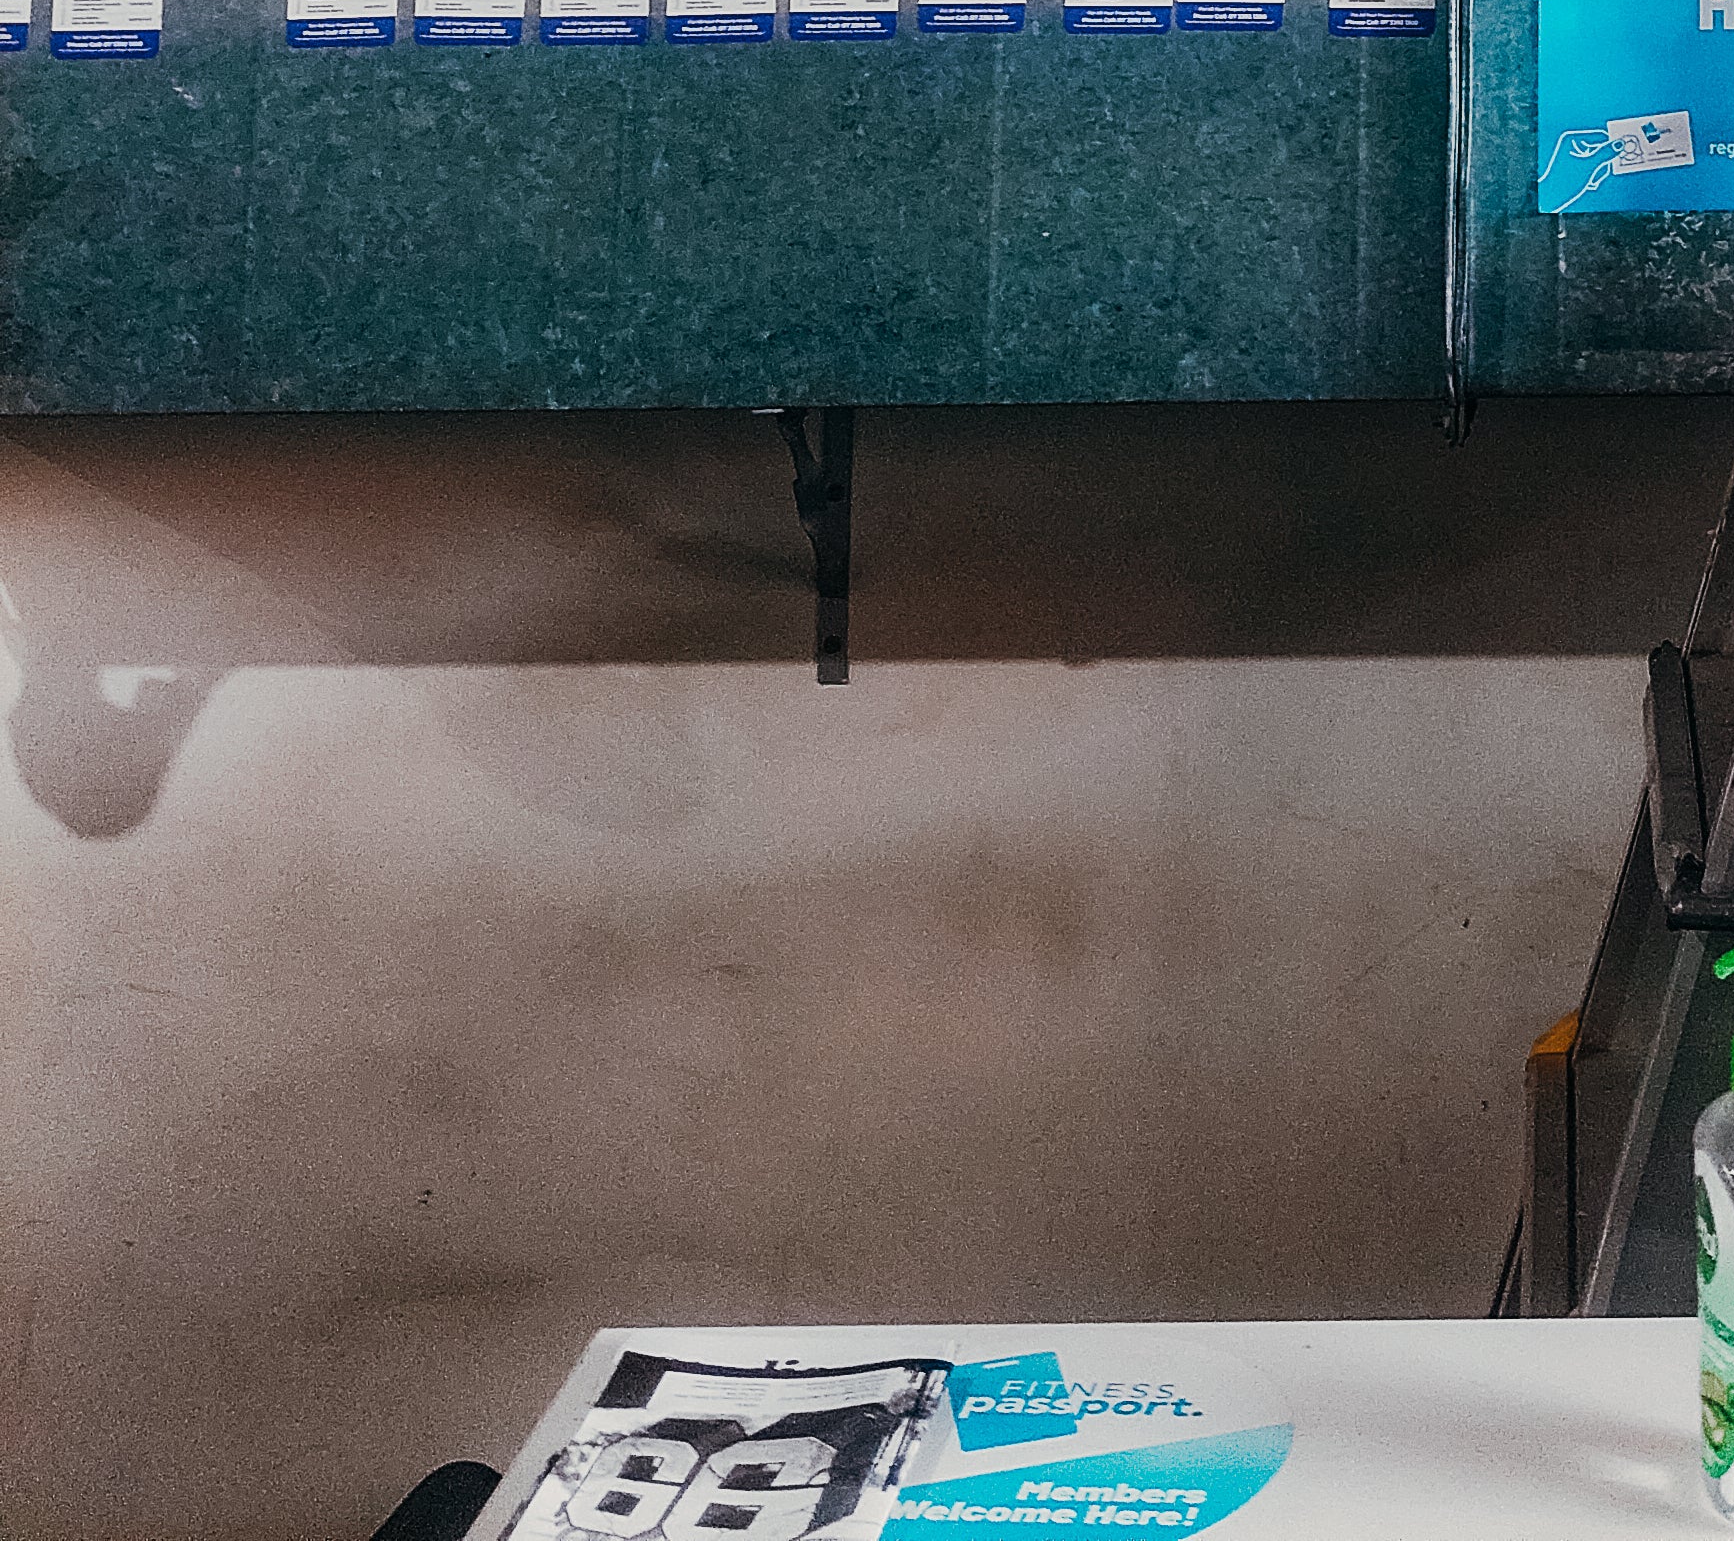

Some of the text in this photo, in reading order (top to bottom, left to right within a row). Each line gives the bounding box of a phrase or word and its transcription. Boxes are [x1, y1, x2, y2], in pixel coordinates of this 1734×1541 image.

[1001, 1379, 1176, 1399] FITNESS
[1016, 1480, 1208, 1505] Members
[889, 1499, 1199, 1528] Welcome Here!
